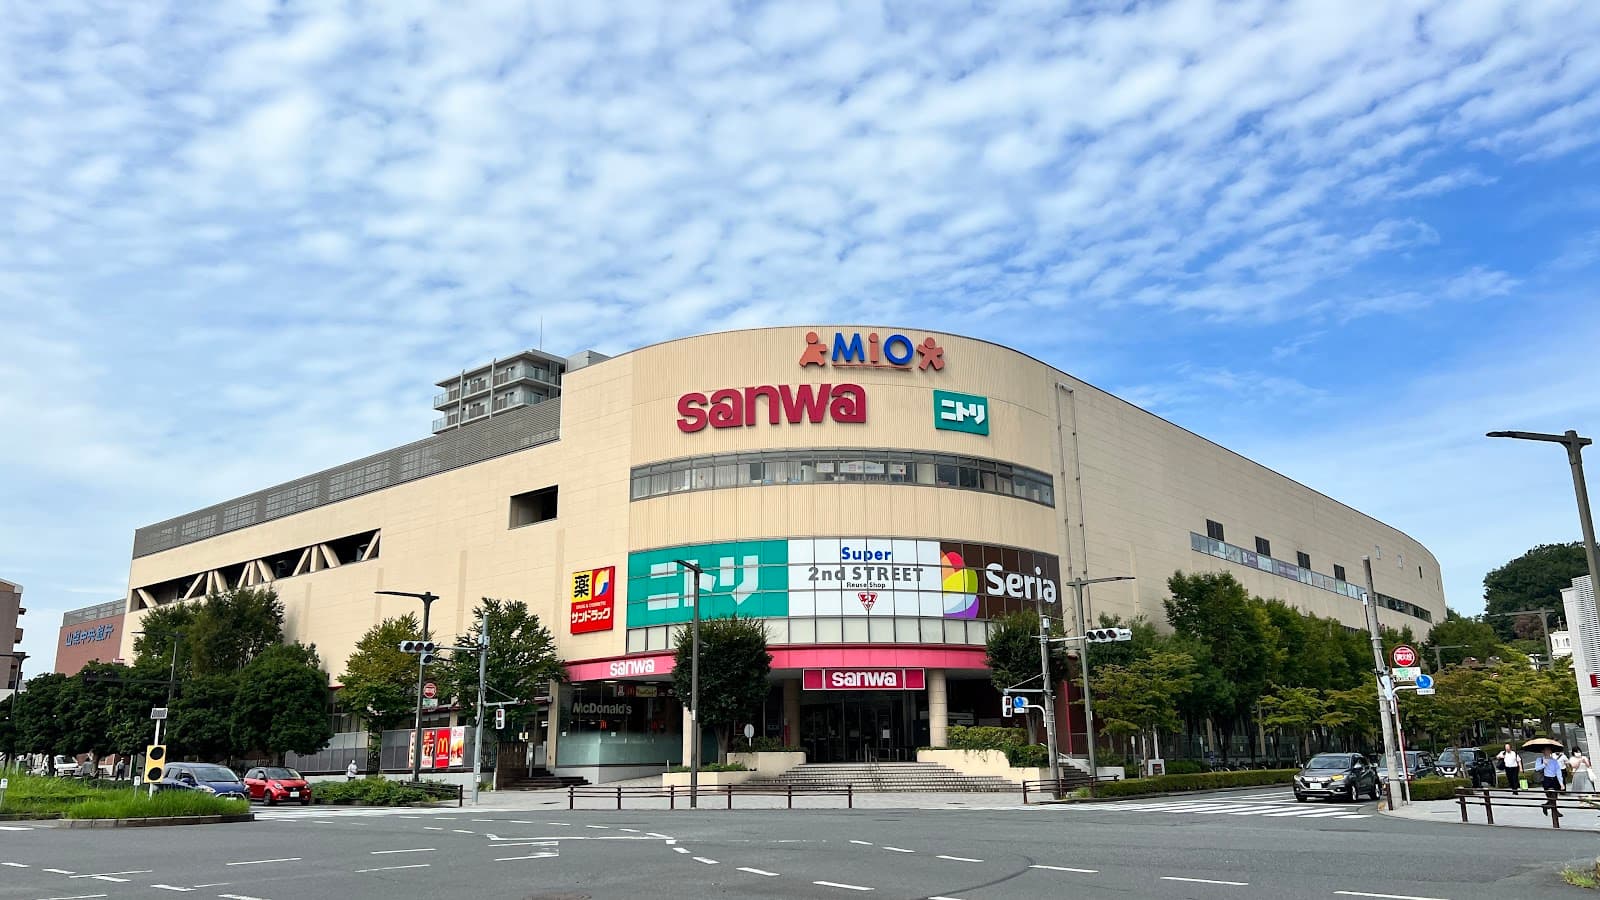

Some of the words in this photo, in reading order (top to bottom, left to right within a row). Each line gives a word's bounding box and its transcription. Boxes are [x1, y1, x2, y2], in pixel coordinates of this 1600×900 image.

[677, 383, 867, 433] sanwa
[940, 398, 986, 425] ニトリ
[842, 546, 892, 562] Super
[647, 554, 759, 611] ニトリ
[808, 566, 846, 581] 2nd
[852, 566, 924, 582] STREET
[985, 562, 1057, 604] Seria
[574, 574, 590, 598] 薬
[846, 581, 867, 589] Reuse
[869, 581, 886, 590] Shop
[572, 607, 611, 624] サンドラック
[609, 658, 655, 677] sanwa
[831, 671, 897, 687] sanwa
[572, 702, 633, 715] McDonald's
